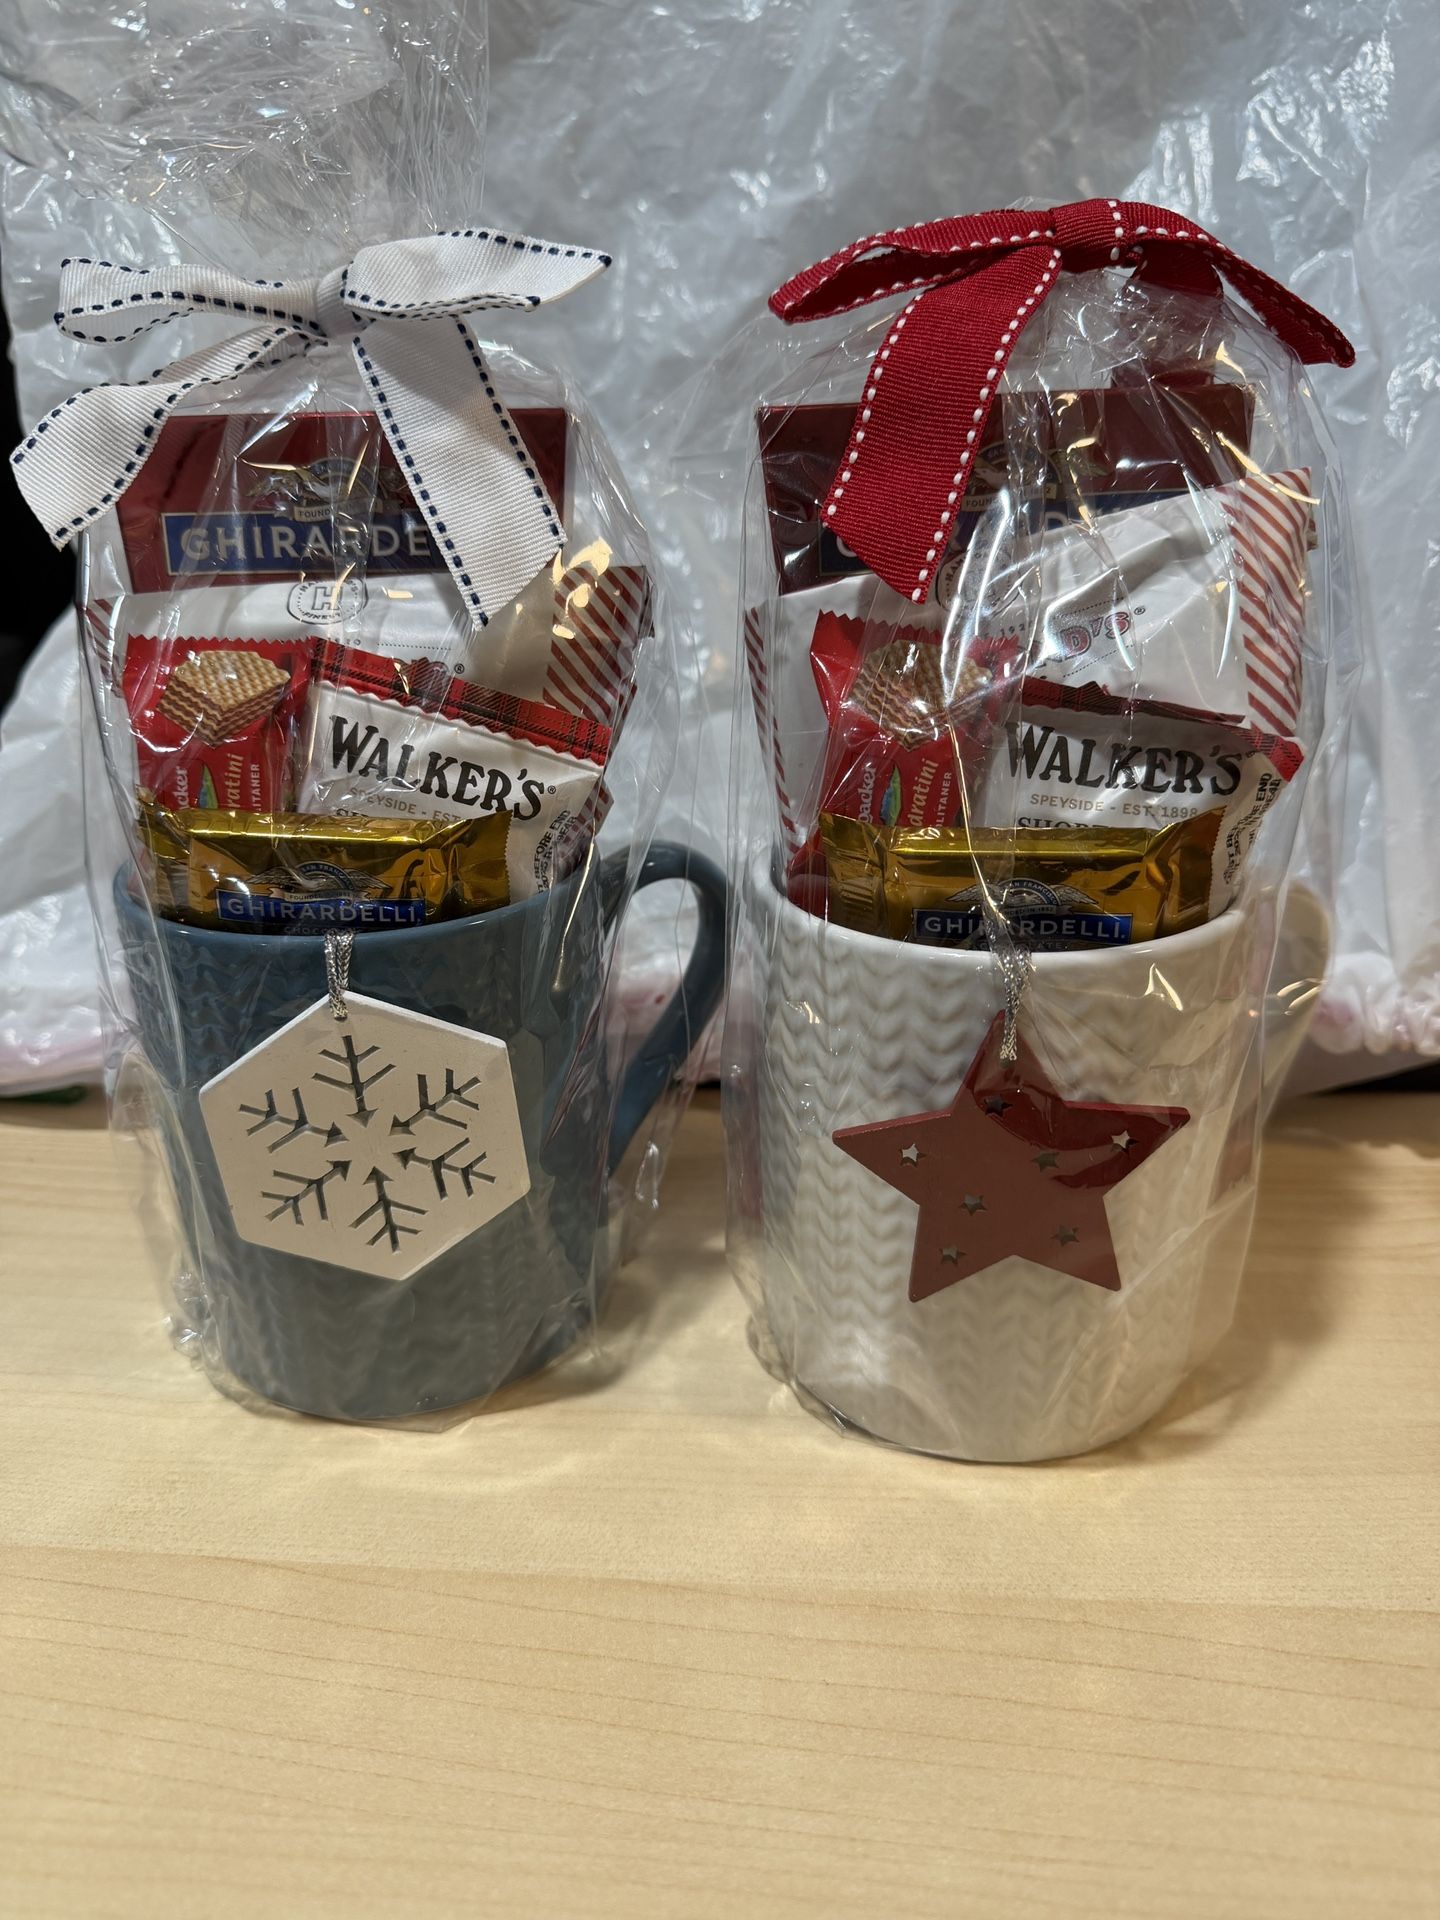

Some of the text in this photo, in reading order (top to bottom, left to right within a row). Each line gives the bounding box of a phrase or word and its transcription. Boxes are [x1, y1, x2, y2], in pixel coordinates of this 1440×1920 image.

[180, 524, 431, 561] GHIRARDE
[224, 753, 244, 808] ratini
[329, 714, 546, 821] WALKER'S
[1004, 721, 1243, 796] WALKER'S
[250, 763, 262, 811] ITANER
[858, 766, 876, 824] oacker
[907, 758, 939, 827] dratini
[935, 771, 953, 828] LITANER
[1030, 793, 1104, 812] SPEYSIDE
[1161, 806, 1198, 818] 1898
[227, 898, 416, 923] GHIRARDELLI
